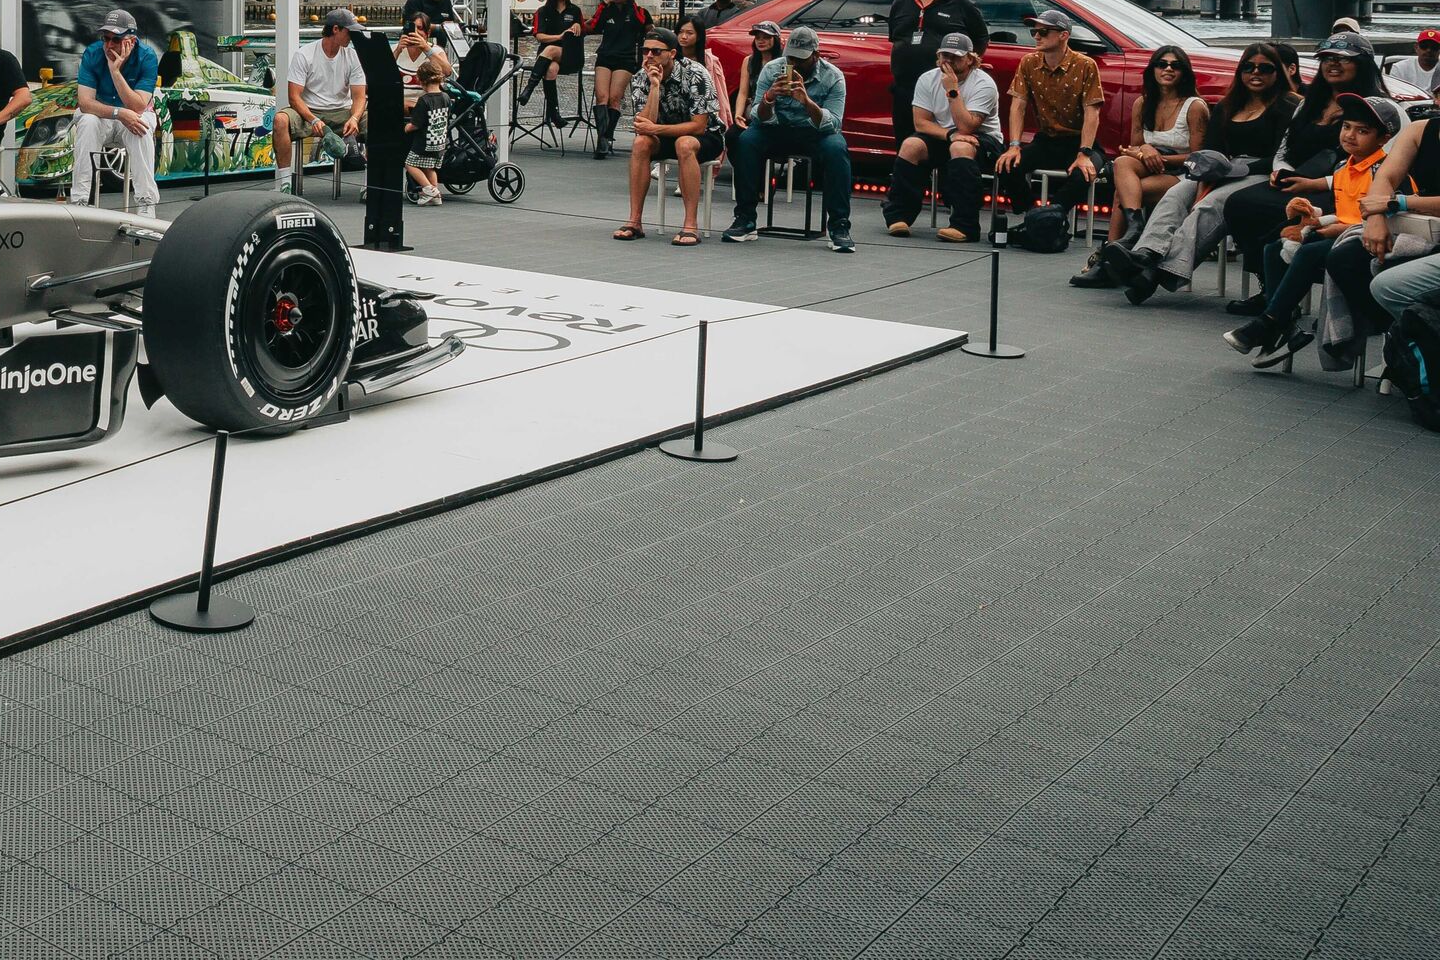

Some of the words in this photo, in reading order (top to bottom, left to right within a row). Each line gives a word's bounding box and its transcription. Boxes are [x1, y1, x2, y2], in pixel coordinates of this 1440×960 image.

[226, 127, 255, 157] 77
[276, 212, 316, 230] PIRELLI
[260, 395, 323, 421] ZERO
